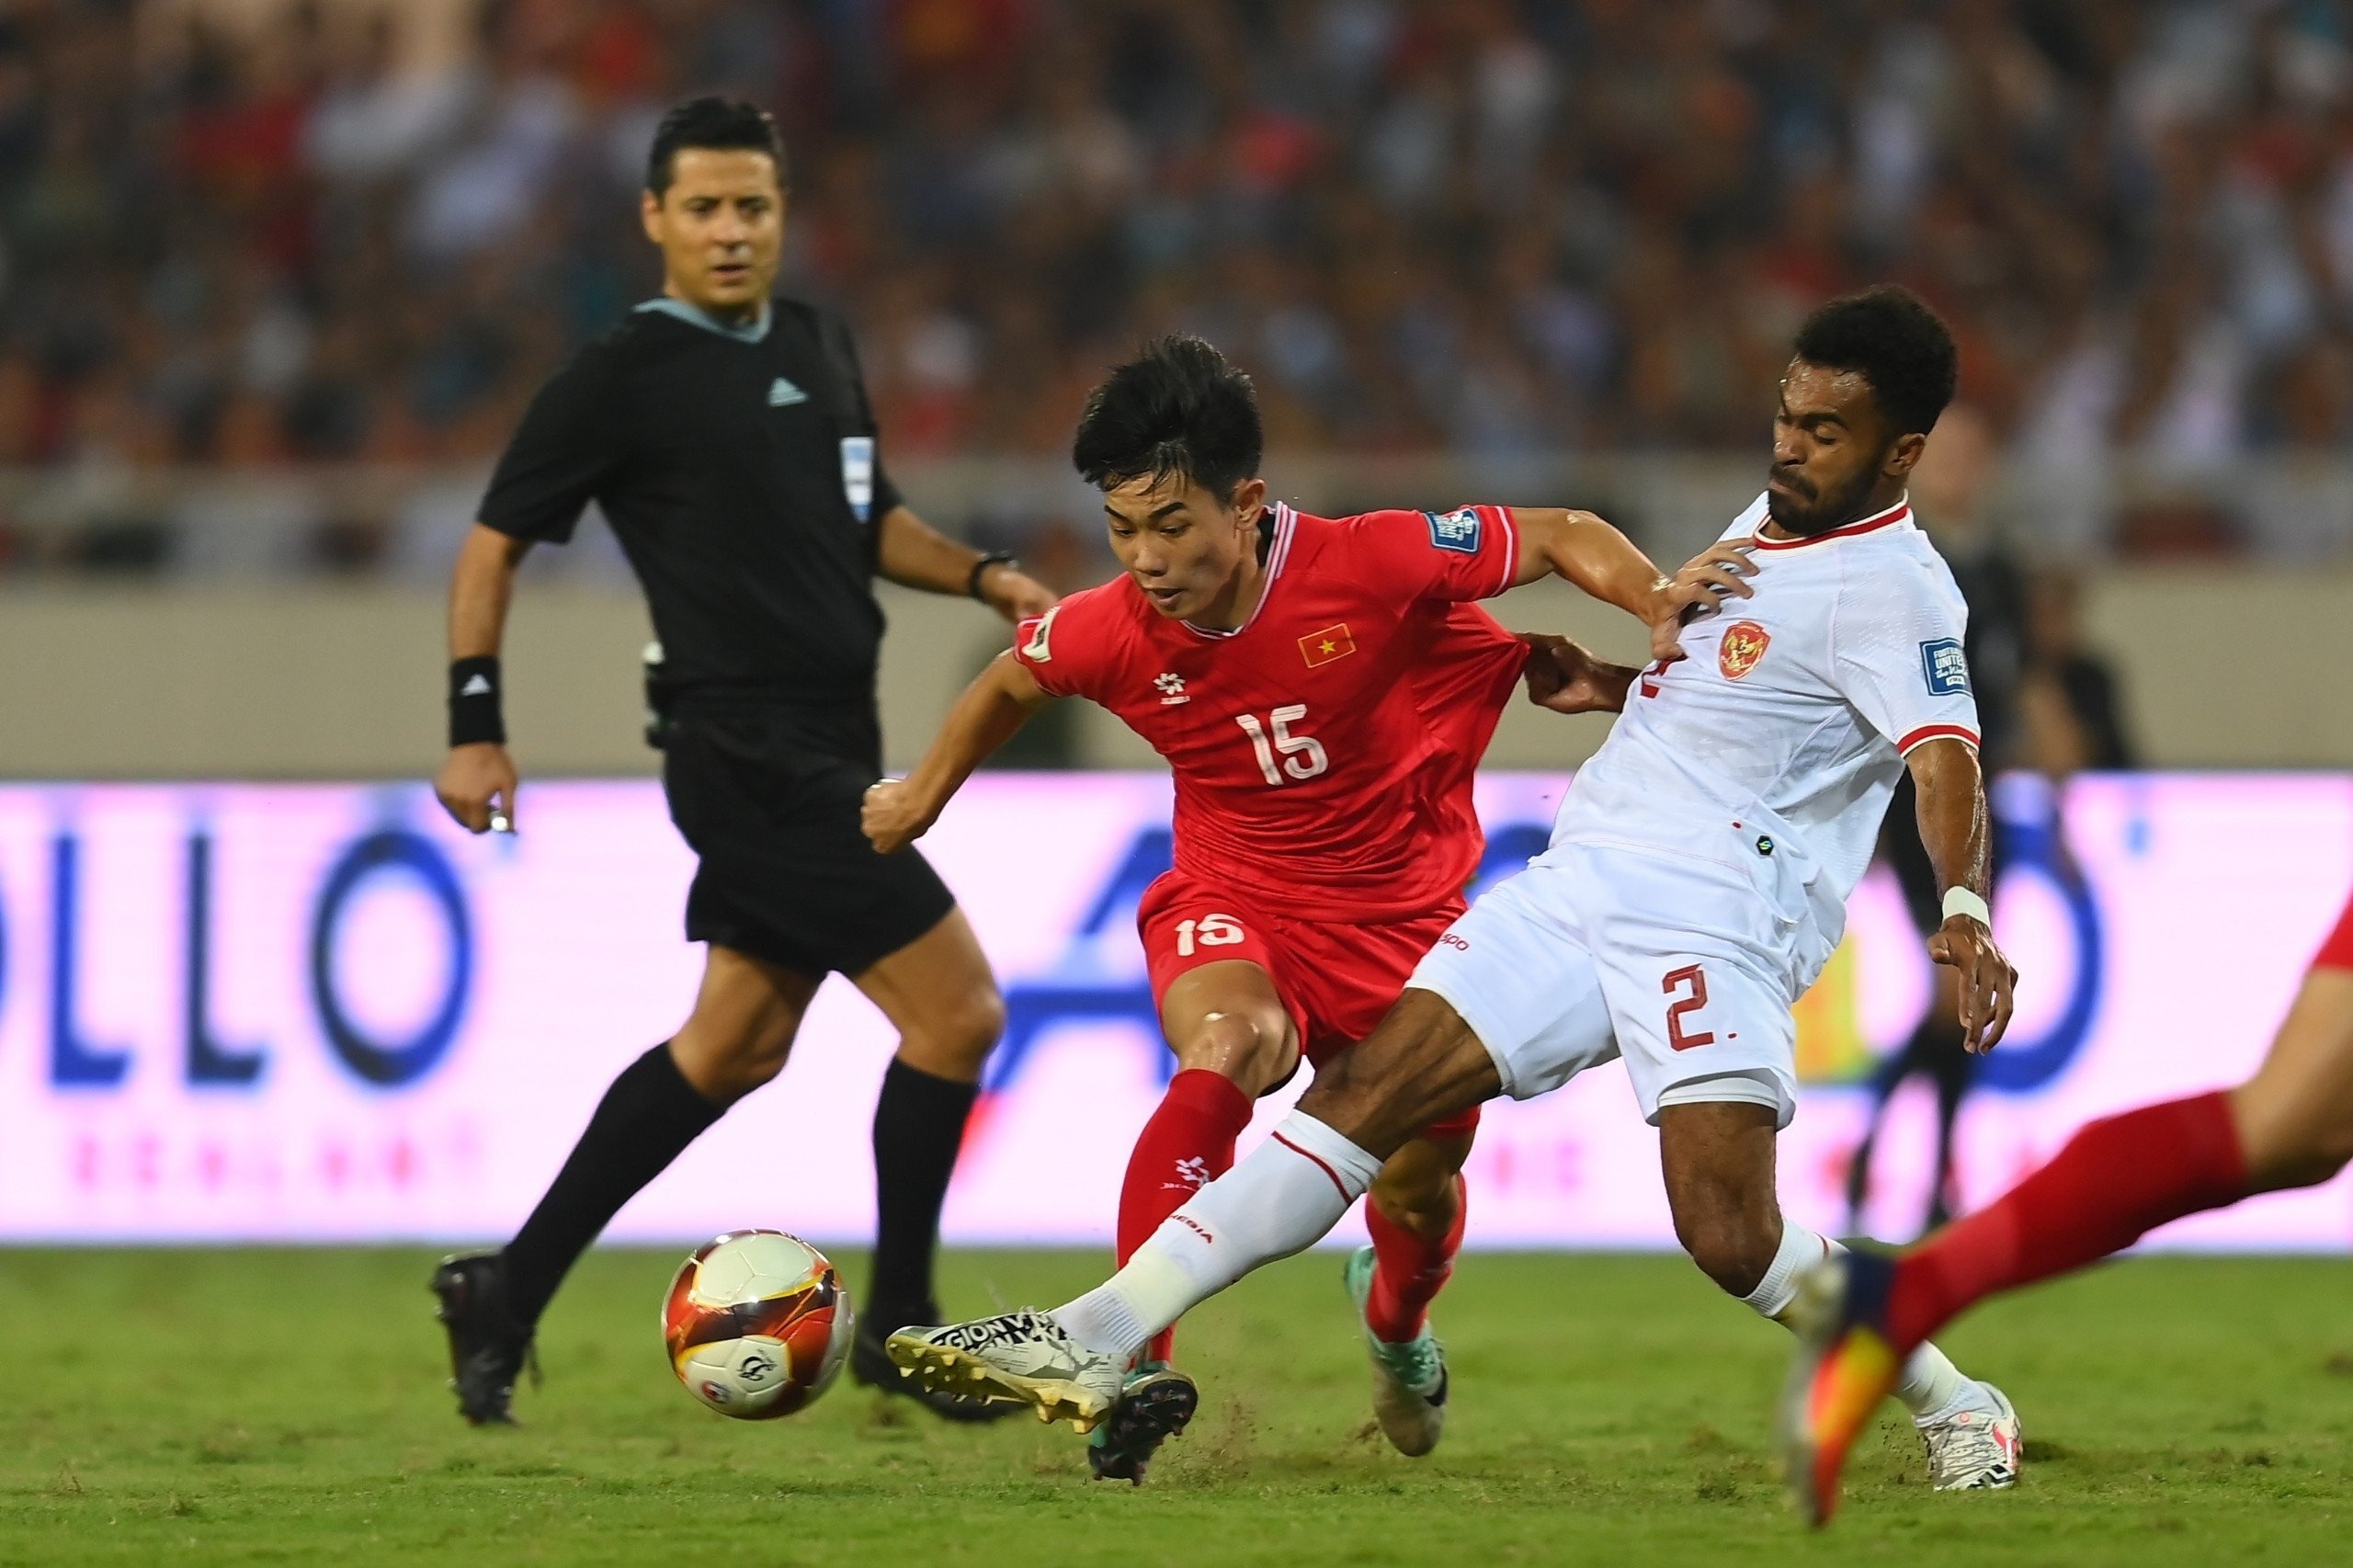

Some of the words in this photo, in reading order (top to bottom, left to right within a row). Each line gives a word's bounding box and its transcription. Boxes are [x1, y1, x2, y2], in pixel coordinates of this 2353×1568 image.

[1235, 704, 1328, 785] 15
[0, 827, 474, 1088] LLO
[1176, 914, 1245, 956] 15
